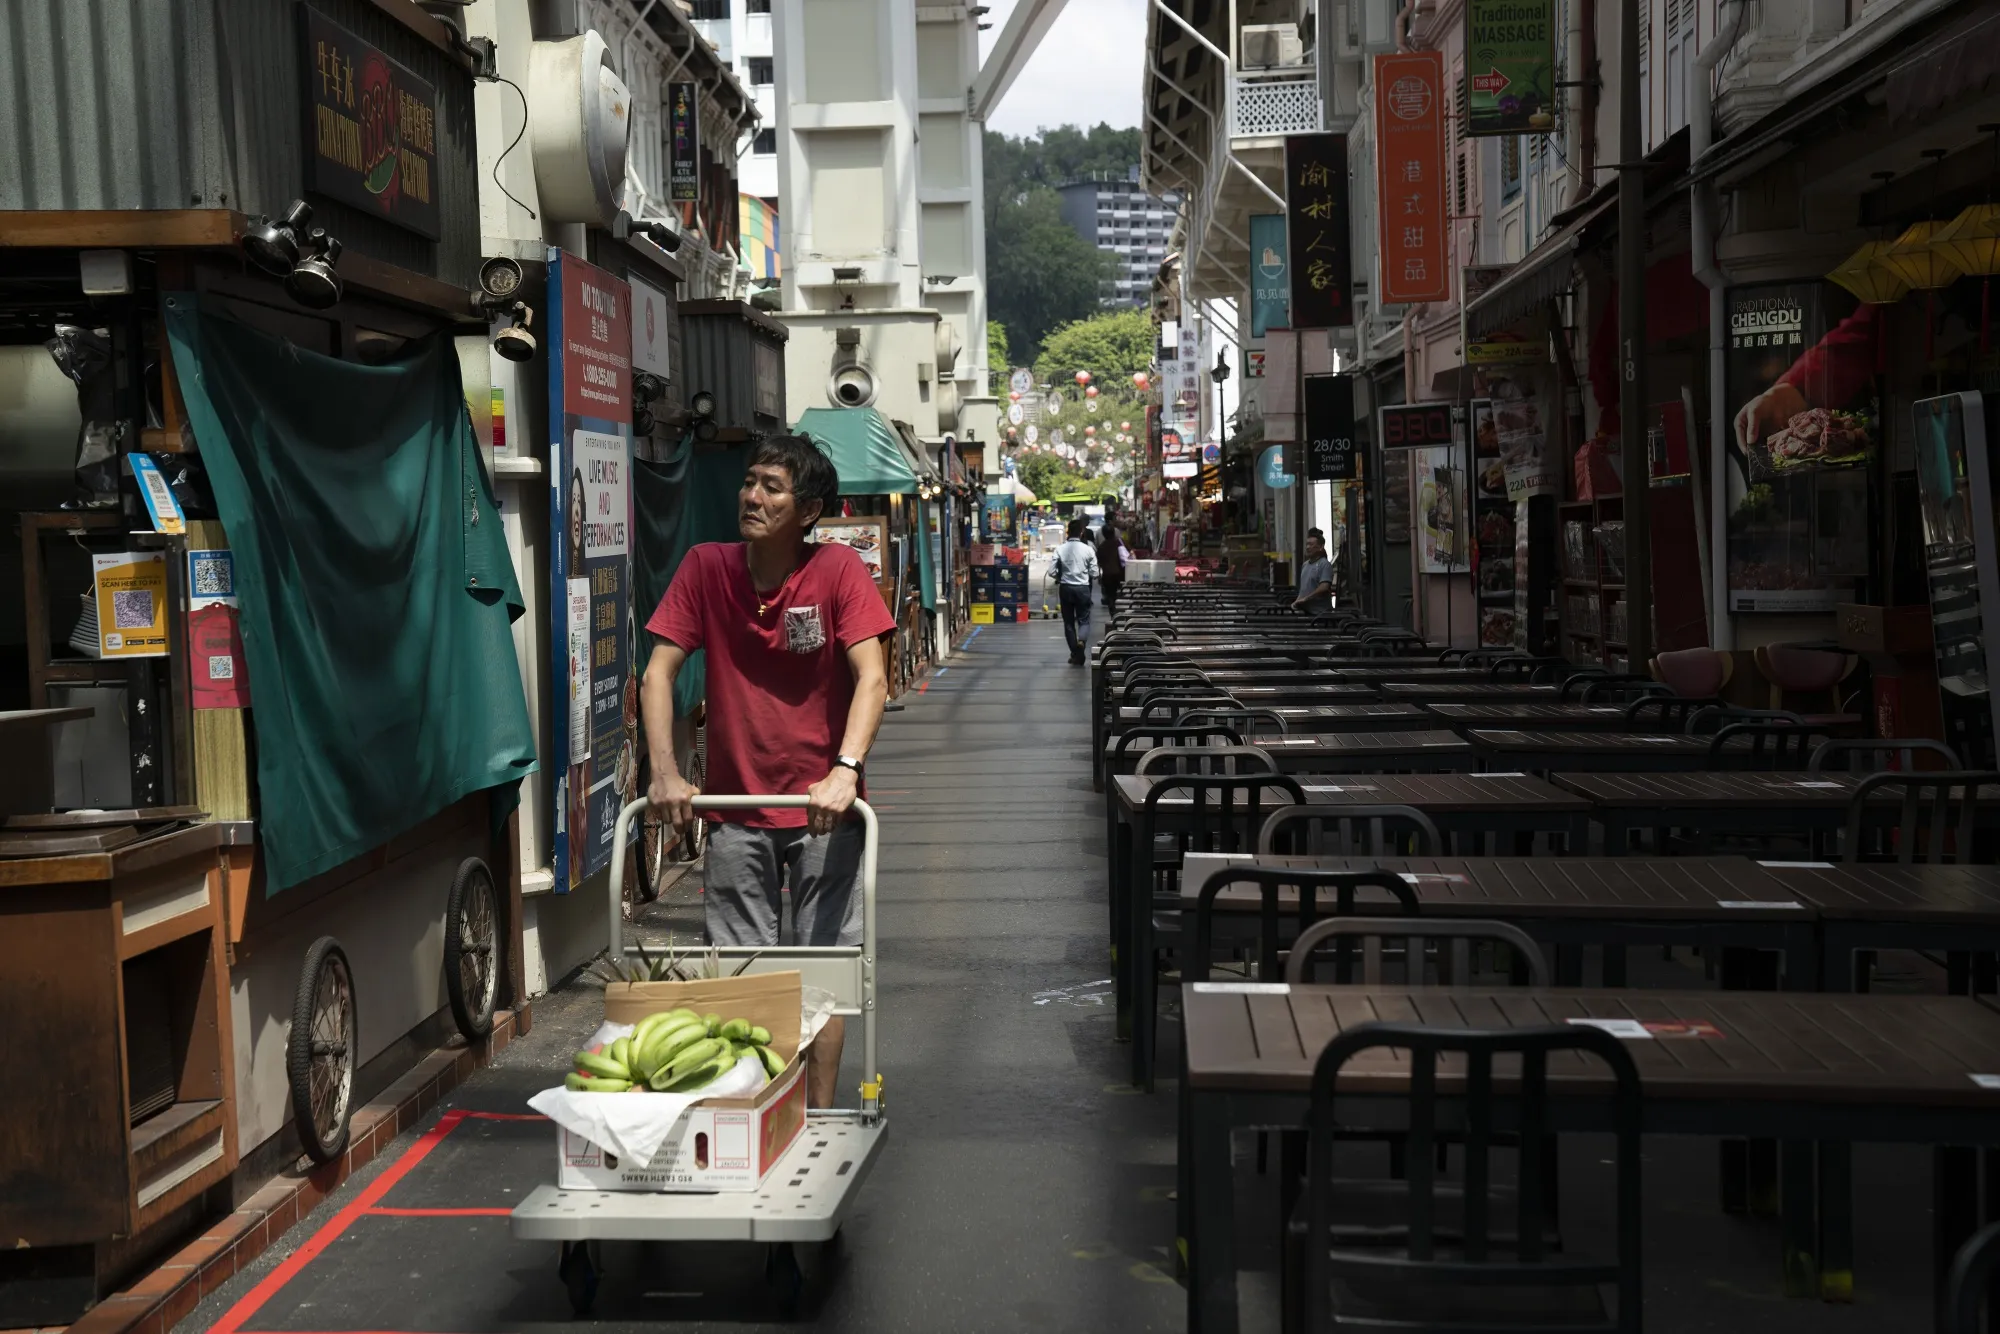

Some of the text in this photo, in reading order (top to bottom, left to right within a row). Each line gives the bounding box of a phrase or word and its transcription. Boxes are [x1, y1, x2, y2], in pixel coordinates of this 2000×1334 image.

[1473, 2, 1546, 22] Traditional
[1474, 23, 1546, 44] MASSAGE
[317, 41, 356, 110] 牛车水
[1475, 78, 1504, 88] THIS WAY
[317, 103, 363, 172] CHINATOWN
[402, 148, 430, 204] SEAFOOD
[1401, 160, 1426, 280] 港式甜品
[582, 281, 616, 320] NO TOUTING
[1732, 296, 1802, 312] TRADITIONAL
[1732, 308, 1802, 328] CHENGDU
[1504, 346, 1521, 356] 22A
[1732, 332, 1802, 349] 地道成都味
[1250, 354, 1265, 376] 7
[1624, 338, 1636, 382] 18
[1385, 410, 1450, 444] BBQ
[1314, 438, 1351, 452] 28/30
[1321, 453, 1344, 462] Smith
[1321, 463, 1345, 472] Street
[589, 458, 618, 485] LIVE MUSIC
[1509, 478, 1526, 492] 22A
[598, 491, 611, 516] AND
[583, 521, 625, 548] PERFORMANCES
[792, 640, 818, 649] LONDON
[594, 674, 619, 696] EVERY SATURDAY
[653, 1175, 675, 1183] EARTH
